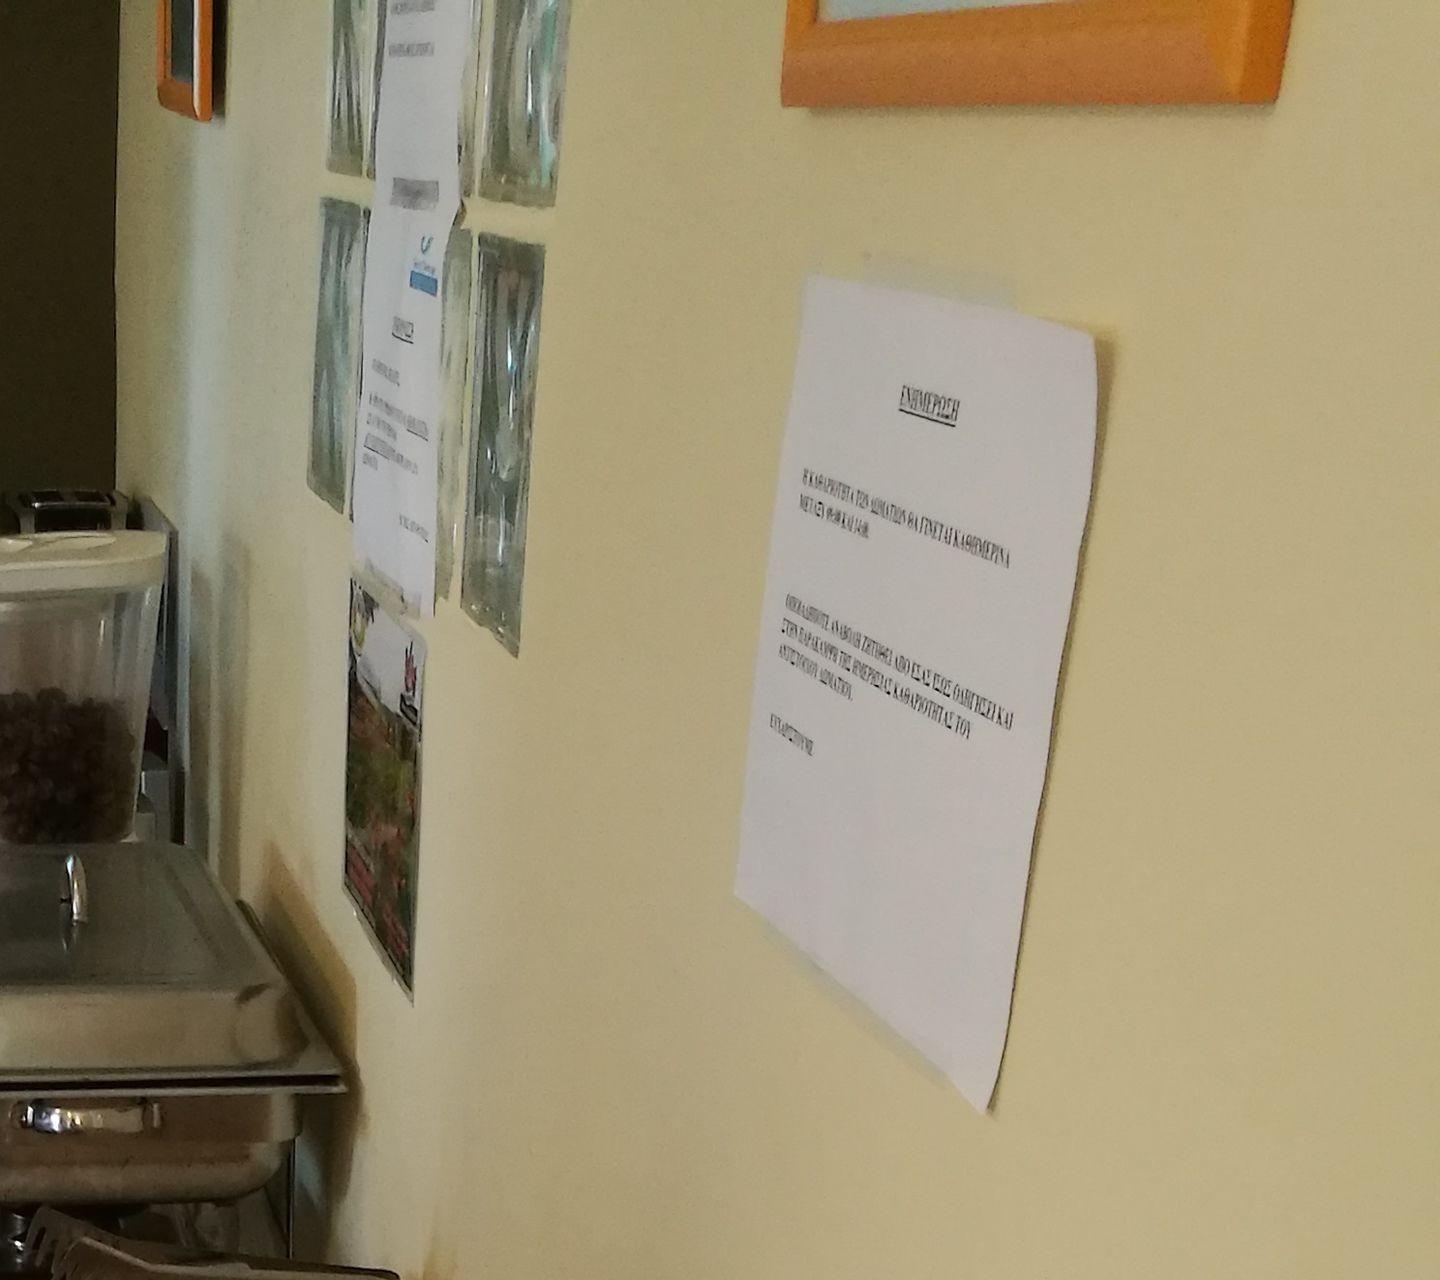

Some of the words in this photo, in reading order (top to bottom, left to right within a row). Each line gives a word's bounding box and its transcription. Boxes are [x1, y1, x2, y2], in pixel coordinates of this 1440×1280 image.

[899, 385, 961, 421] ΕΝΗΜΕΡΩΣΗ
[919, 515, 952, 545] ΓΙΝΕΤΑΙ
[953, 526, 1011, 569] ΚΑΘΗΜΕΡΙΝΑ
